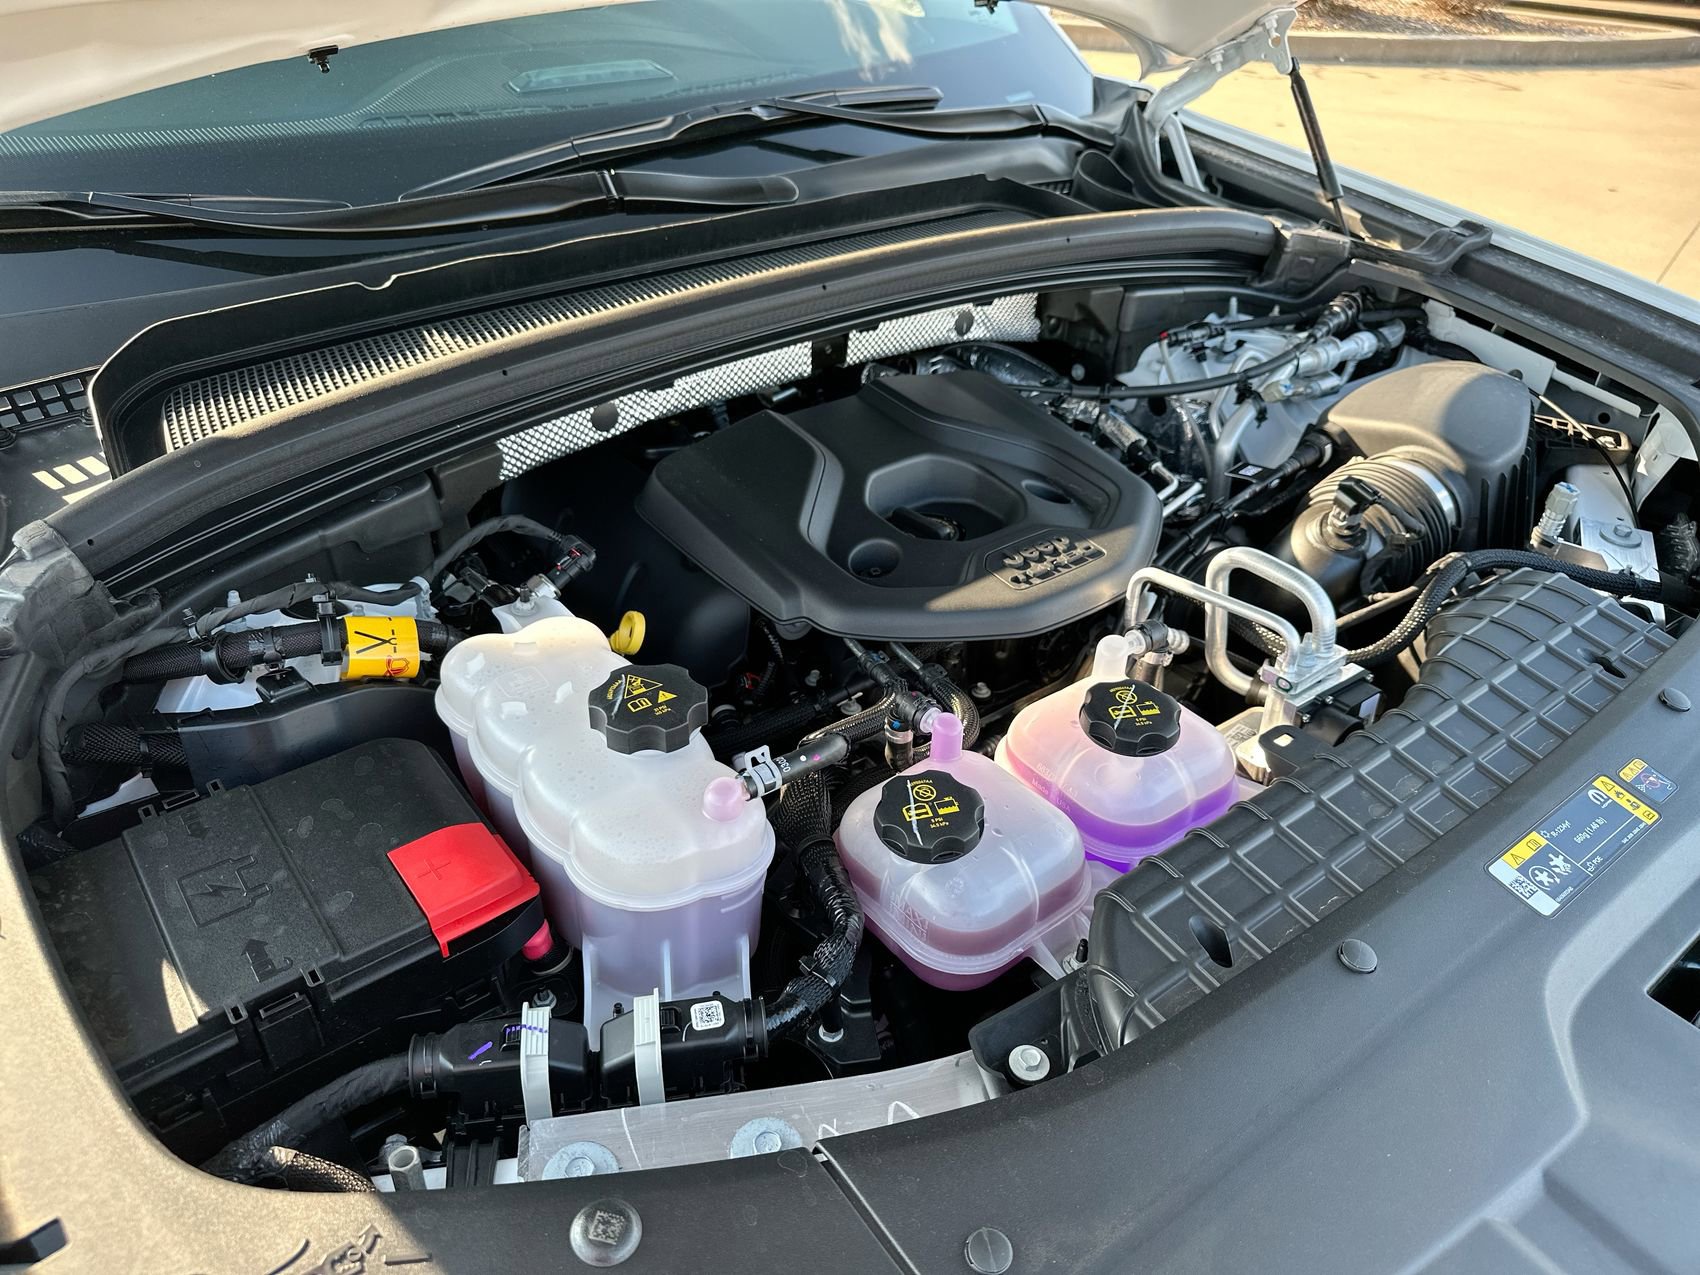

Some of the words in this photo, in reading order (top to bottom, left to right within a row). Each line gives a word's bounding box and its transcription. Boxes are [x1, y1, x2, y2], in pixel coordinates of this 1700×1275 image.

[1003, 537, 1070, 568] Jeep
[1550, 820, 1571, 837] R-1234yf
[1595, 816, 1608, 827] lb)
[1592, 855, 1604, 865] POE
